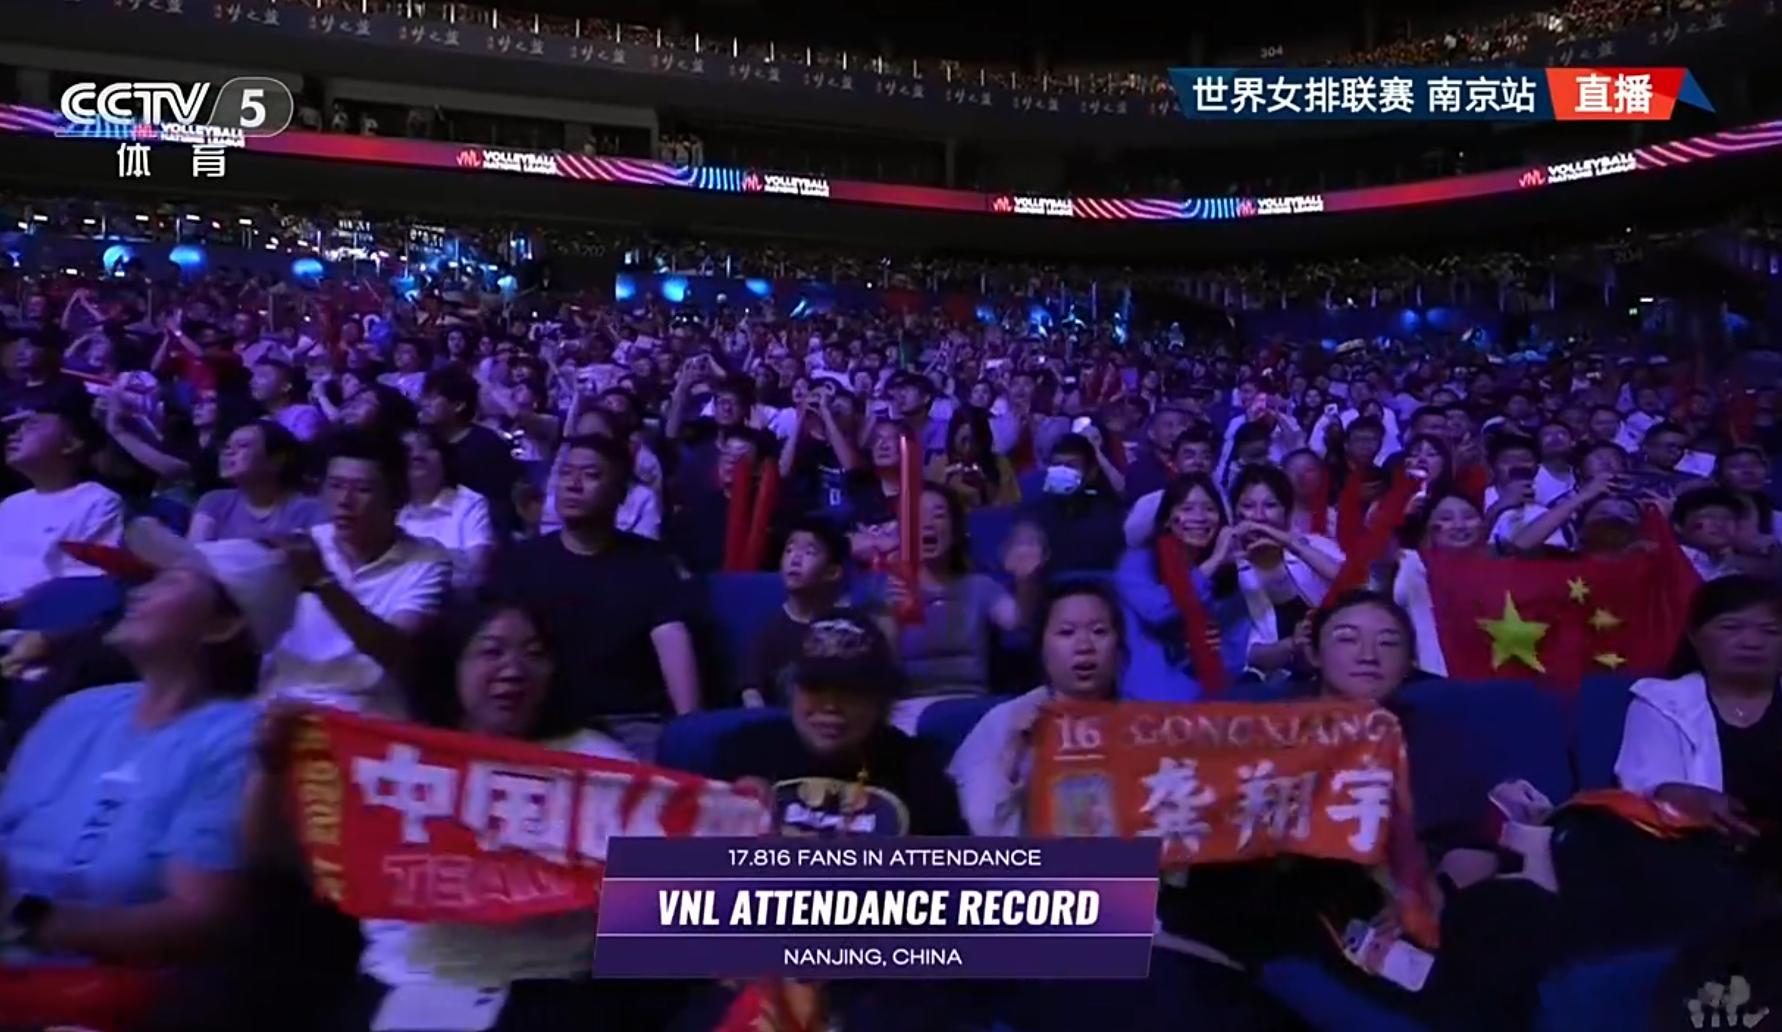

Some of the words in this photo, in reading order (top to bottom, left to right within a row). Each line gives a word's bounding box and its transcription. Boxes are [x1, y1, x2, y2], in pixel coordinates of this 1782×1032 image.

[160, 121, 244, 138] VOLLEYBALL
[482, 149, 556, 166] VOLLEYBALL
[1547, 151, 1636, 176] VOLLEYBALL
[763, 174, 828, 188] VOLLEYBALL
[1054, 714, 1101, 749] 16
[1136, 754, 1394, 854] 龚翔宇
